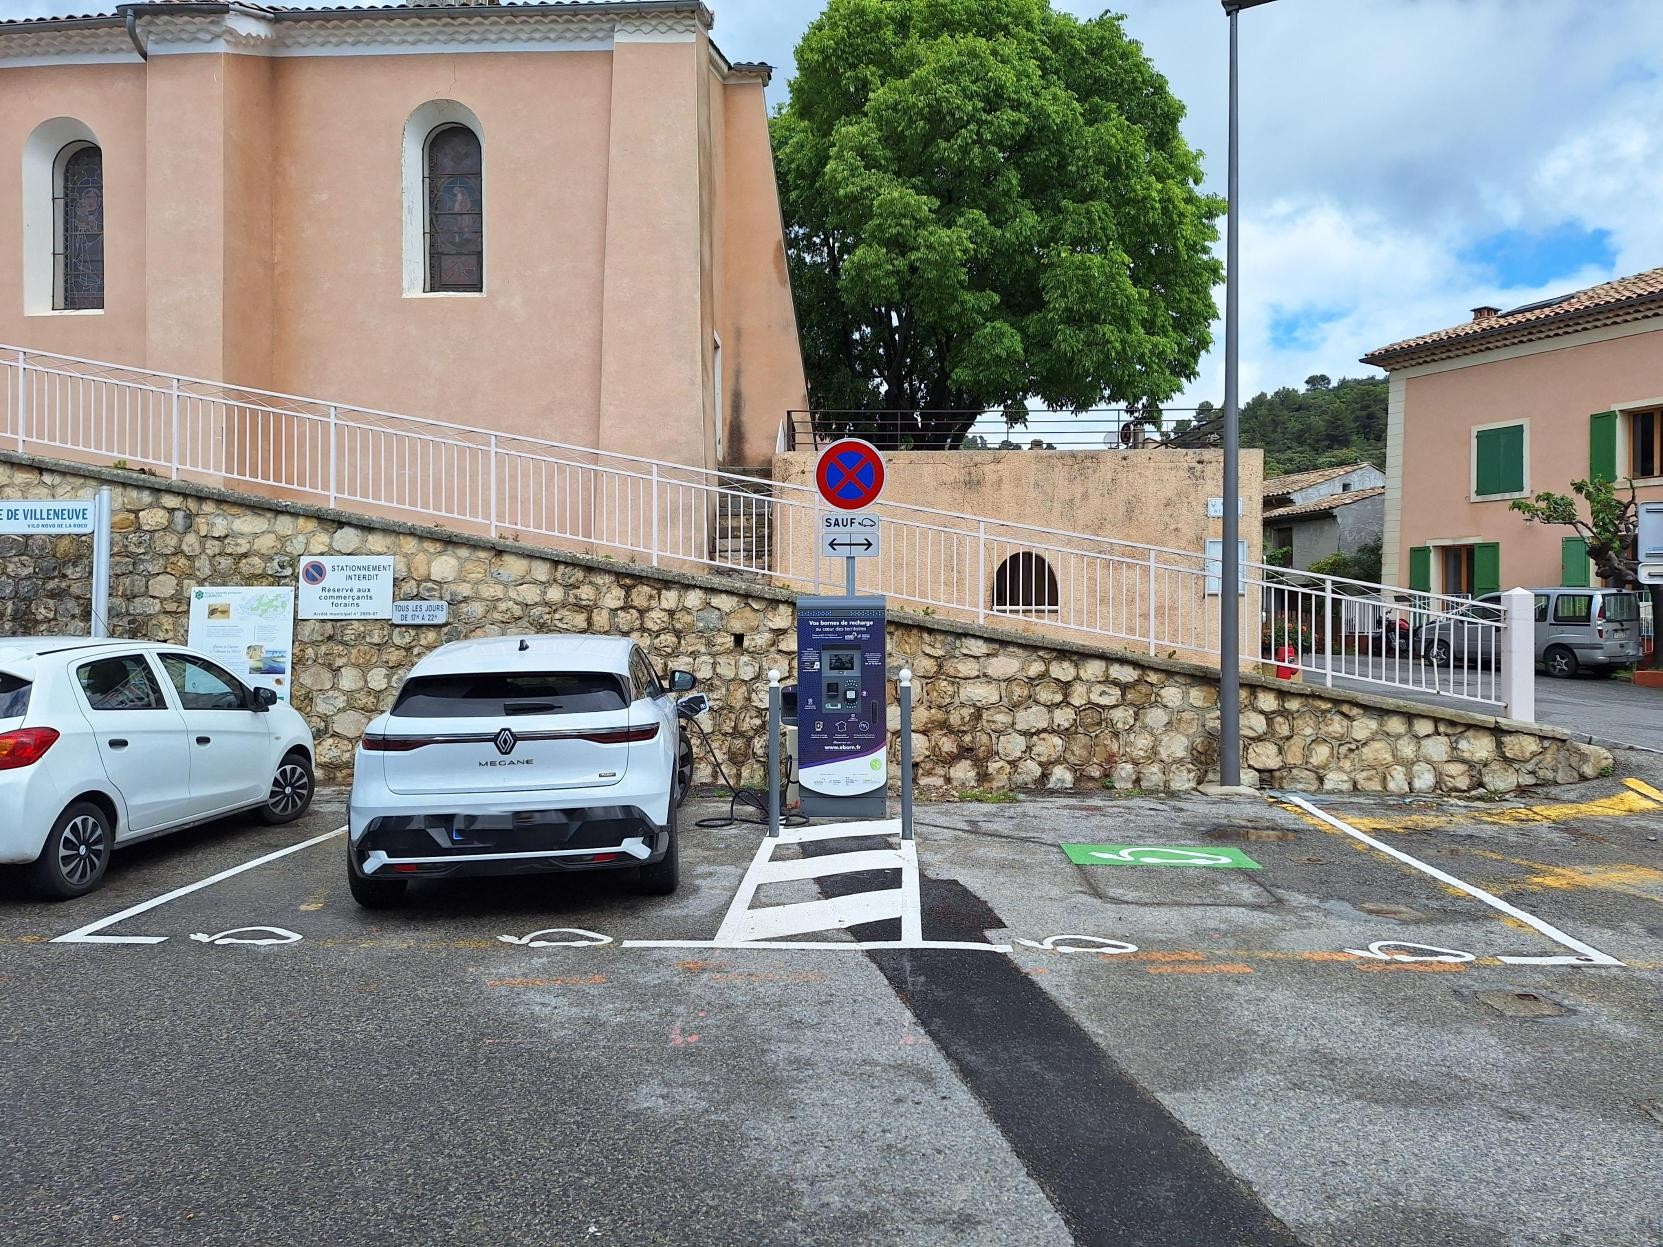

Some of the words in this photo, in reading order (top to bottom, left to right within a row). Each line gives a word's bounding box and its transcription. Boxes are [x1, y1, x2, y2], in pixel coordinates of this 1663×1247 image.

[6, 508, 20, 520] DE
[22, 508, 88, 520] VILLENEUVE
[825, 517, 857, 528] SAUF
[331, 564, 392, 572] STATIONNEMENT
[345, 573, 379, 581] INTERDIT
[395, 604, 410, 612] TOUS
[412, 604, 423, 612] LES
[425, 604, 444, 612] JOURS
[400, 613, 408, 621] DE
[849, 619, 874, 627] recharge
[478, 759, 535, 767] MEGANE
